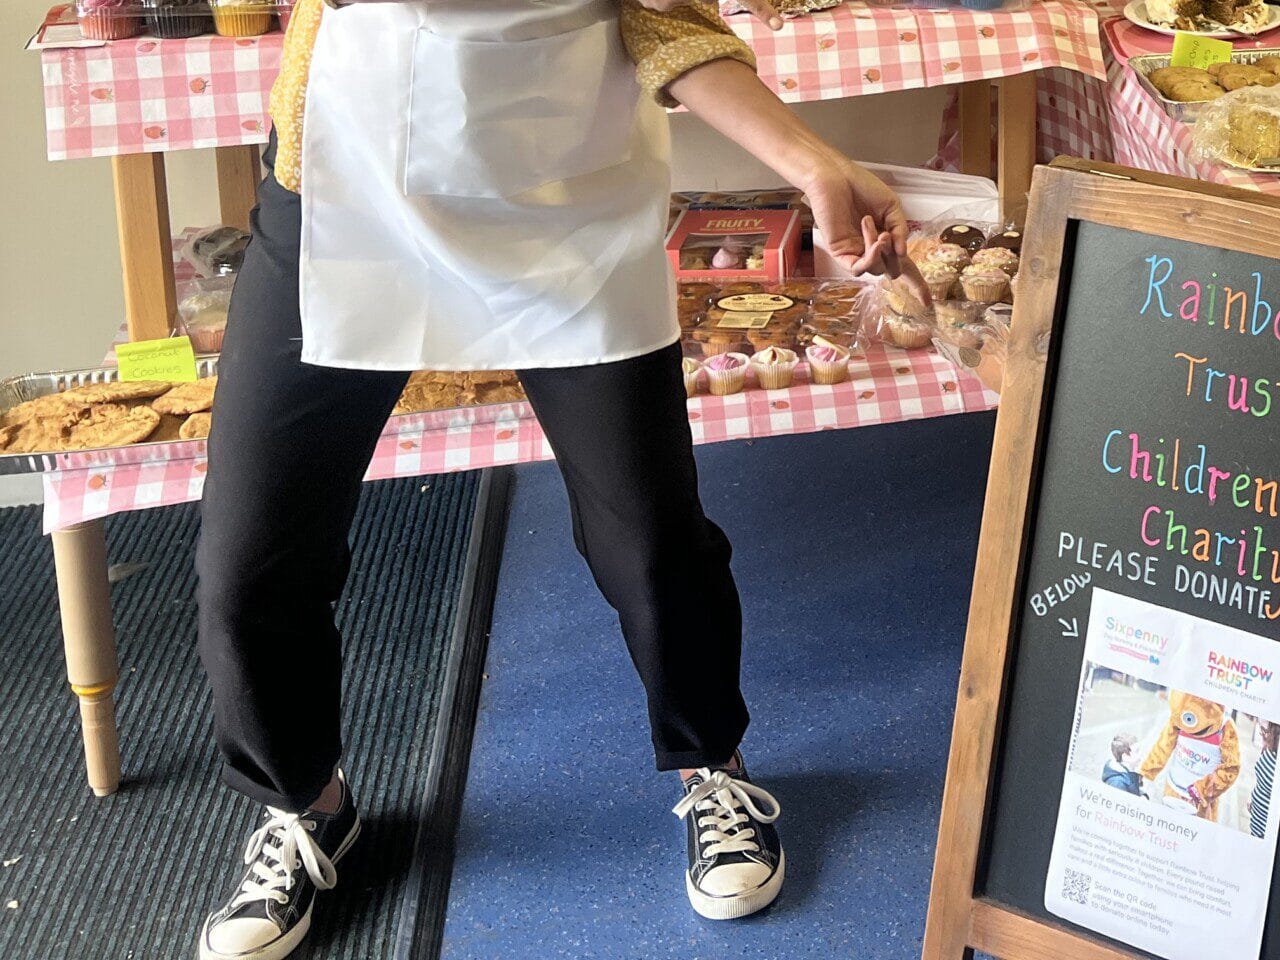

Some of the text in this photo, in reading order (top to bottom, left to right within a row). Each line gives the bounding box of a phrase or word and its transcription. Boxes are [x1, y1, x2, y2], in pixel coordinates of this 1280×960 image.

[706, 218, 763, 229] FRUITY
[132, 365, 182, 379] Cookies
[1058, 532, 1274, 620] PLEASE DONATE
[1029, 571, 1093, 618] BELOW
[1105, 616, 1170, 650] Sixpenny
[1207, 665, 1253, 690] TRUST
[1208, 651, 1273, 682] RAINBOW
[1076, 804, 1178, 853] for Rainbow Trust
[1079, 786, 1199, 842] We're raising money
[1094, 881, 1112, 893] Scan
[1113, 889, 1125, 899] the
[1126, 893, 1139, 904] QR
[1100, 904, 1125, 918] donate
[1126, 914, 1148, 927] online
[1149, 922, 1170, 936] today
[1130, 906, 1174, 928] smartphone
